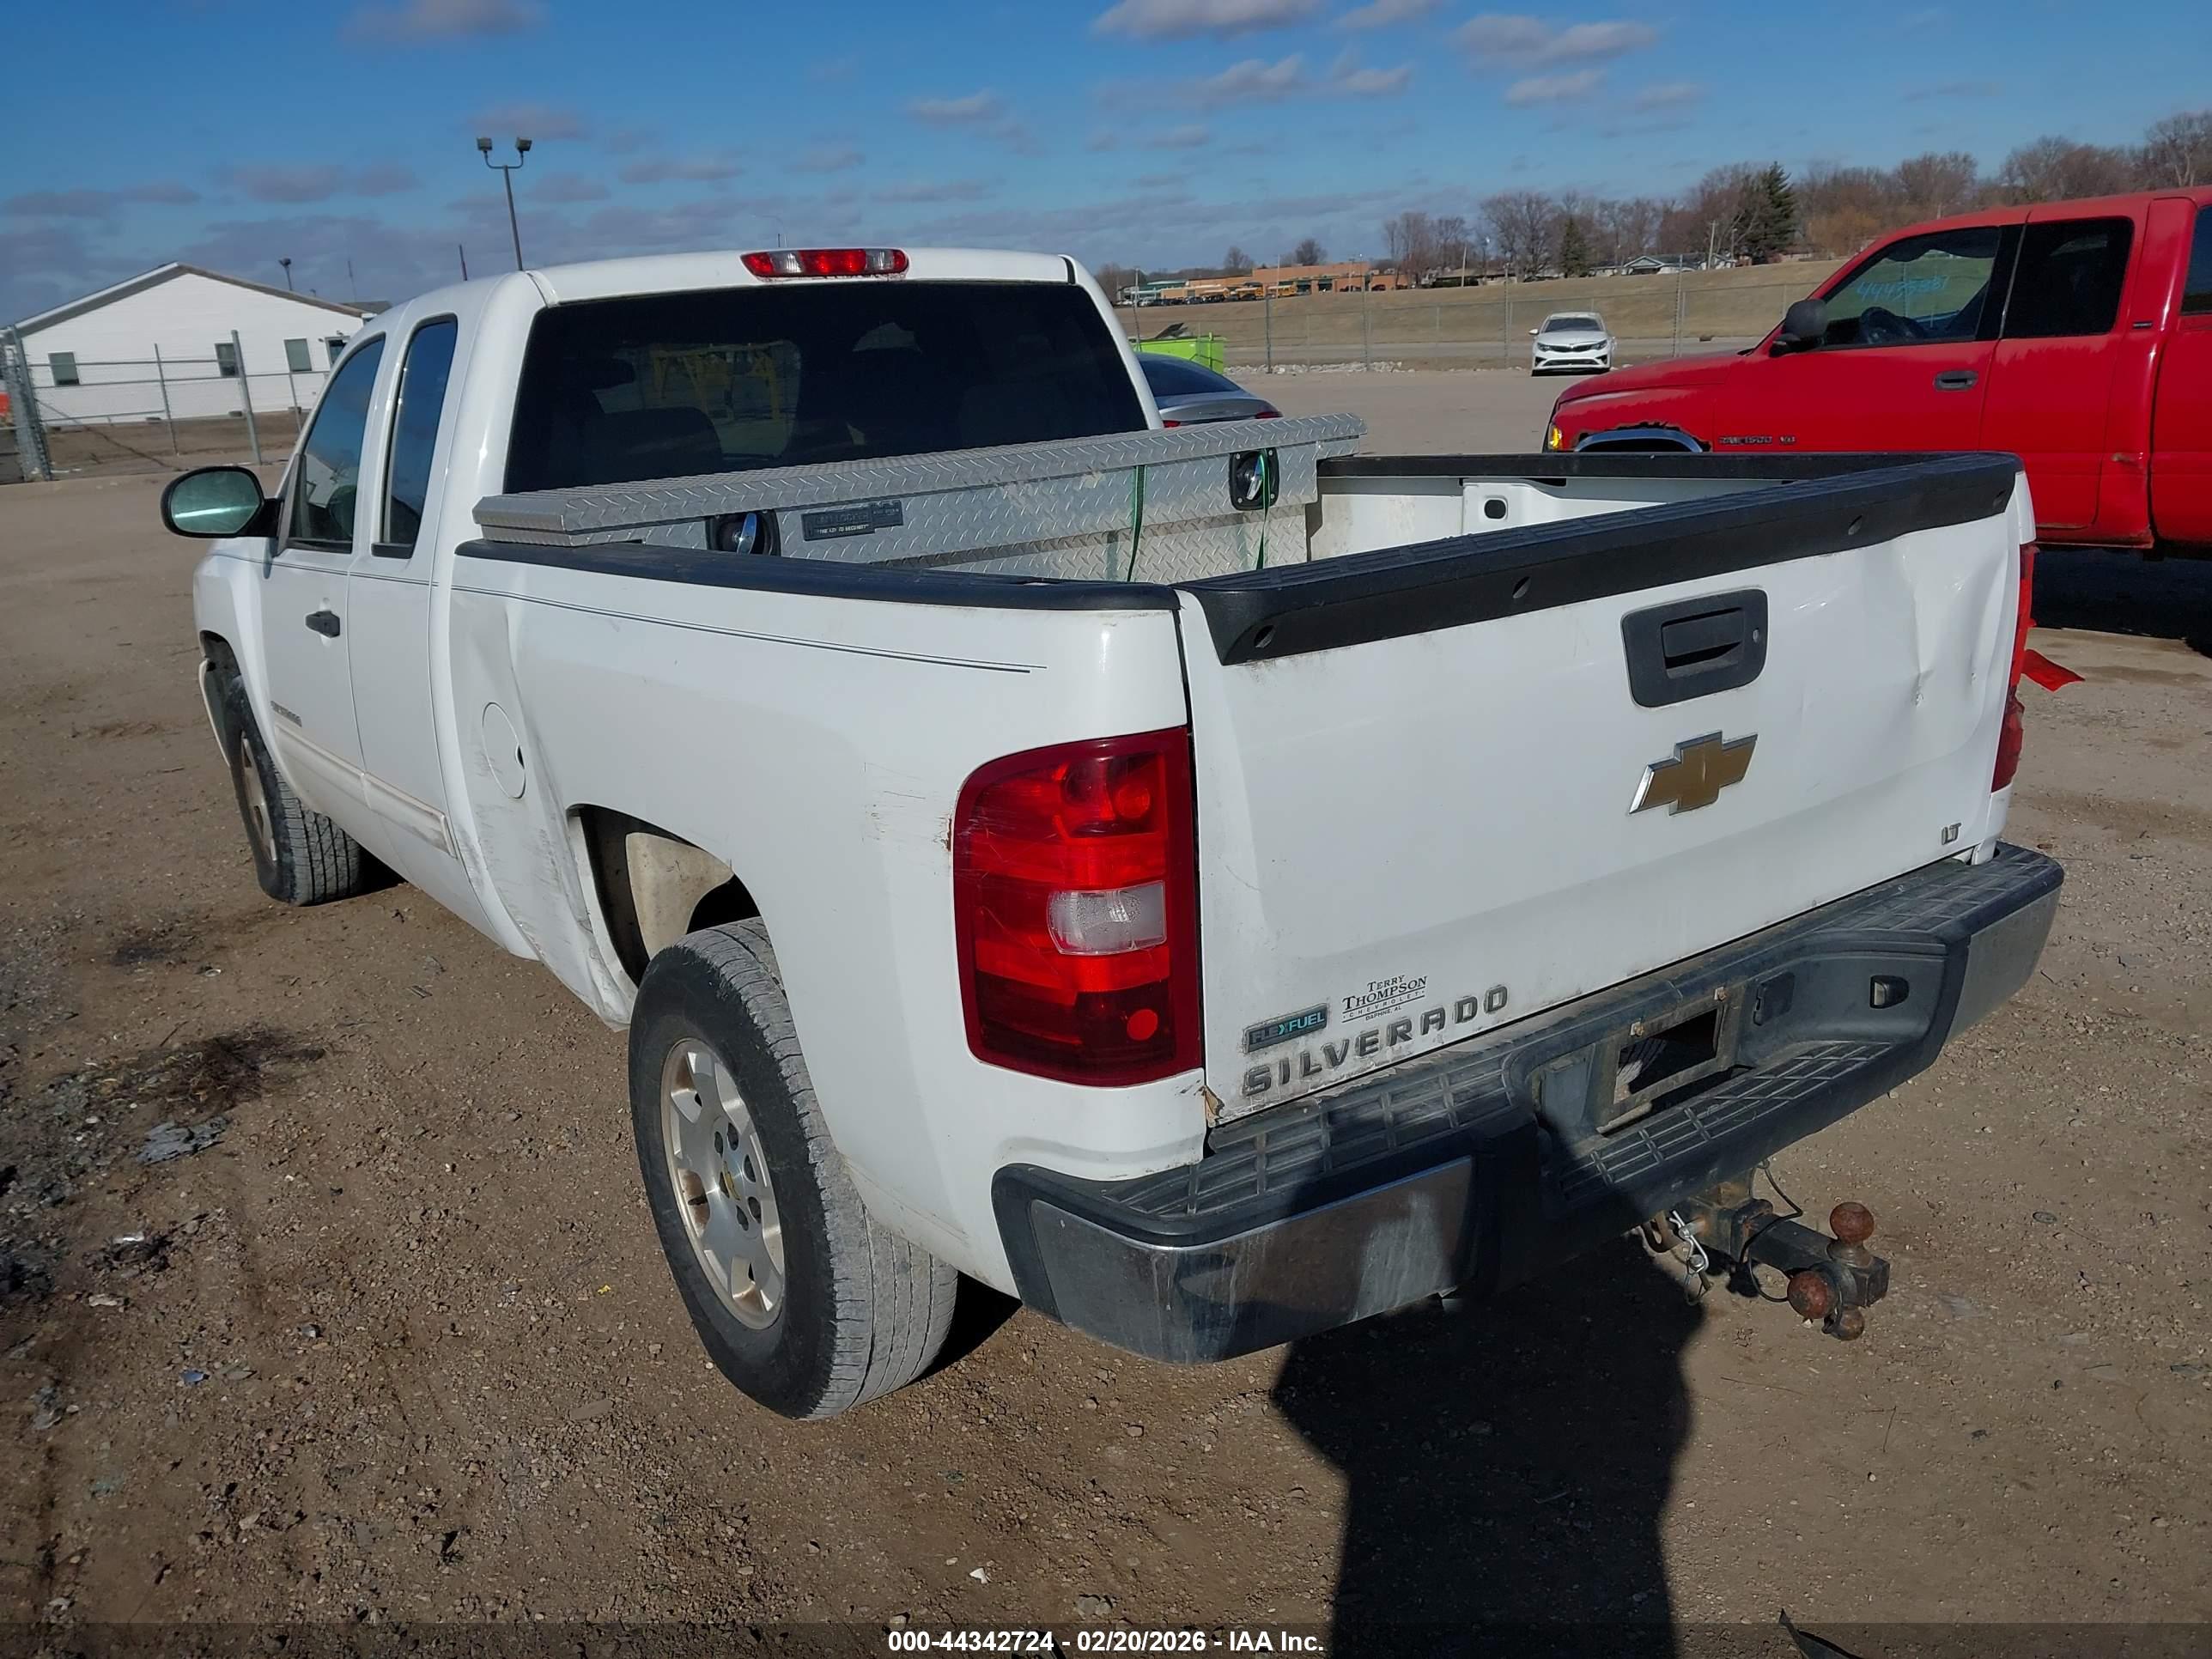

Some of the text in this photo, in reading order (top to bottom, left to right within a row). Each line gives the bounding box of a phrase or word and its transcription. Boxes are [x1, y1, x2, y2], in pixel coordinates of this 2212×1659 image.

[1341, 975, 1427, 1011] THOMPSON
[1367, 975, 1405, 993] TERRY
[1349, 991, 1420, 1018] CHEVROLET
[1289, 1012, 1325, 1032] FUEL
[1243, 985, 1508, 1097] SILVERADO
